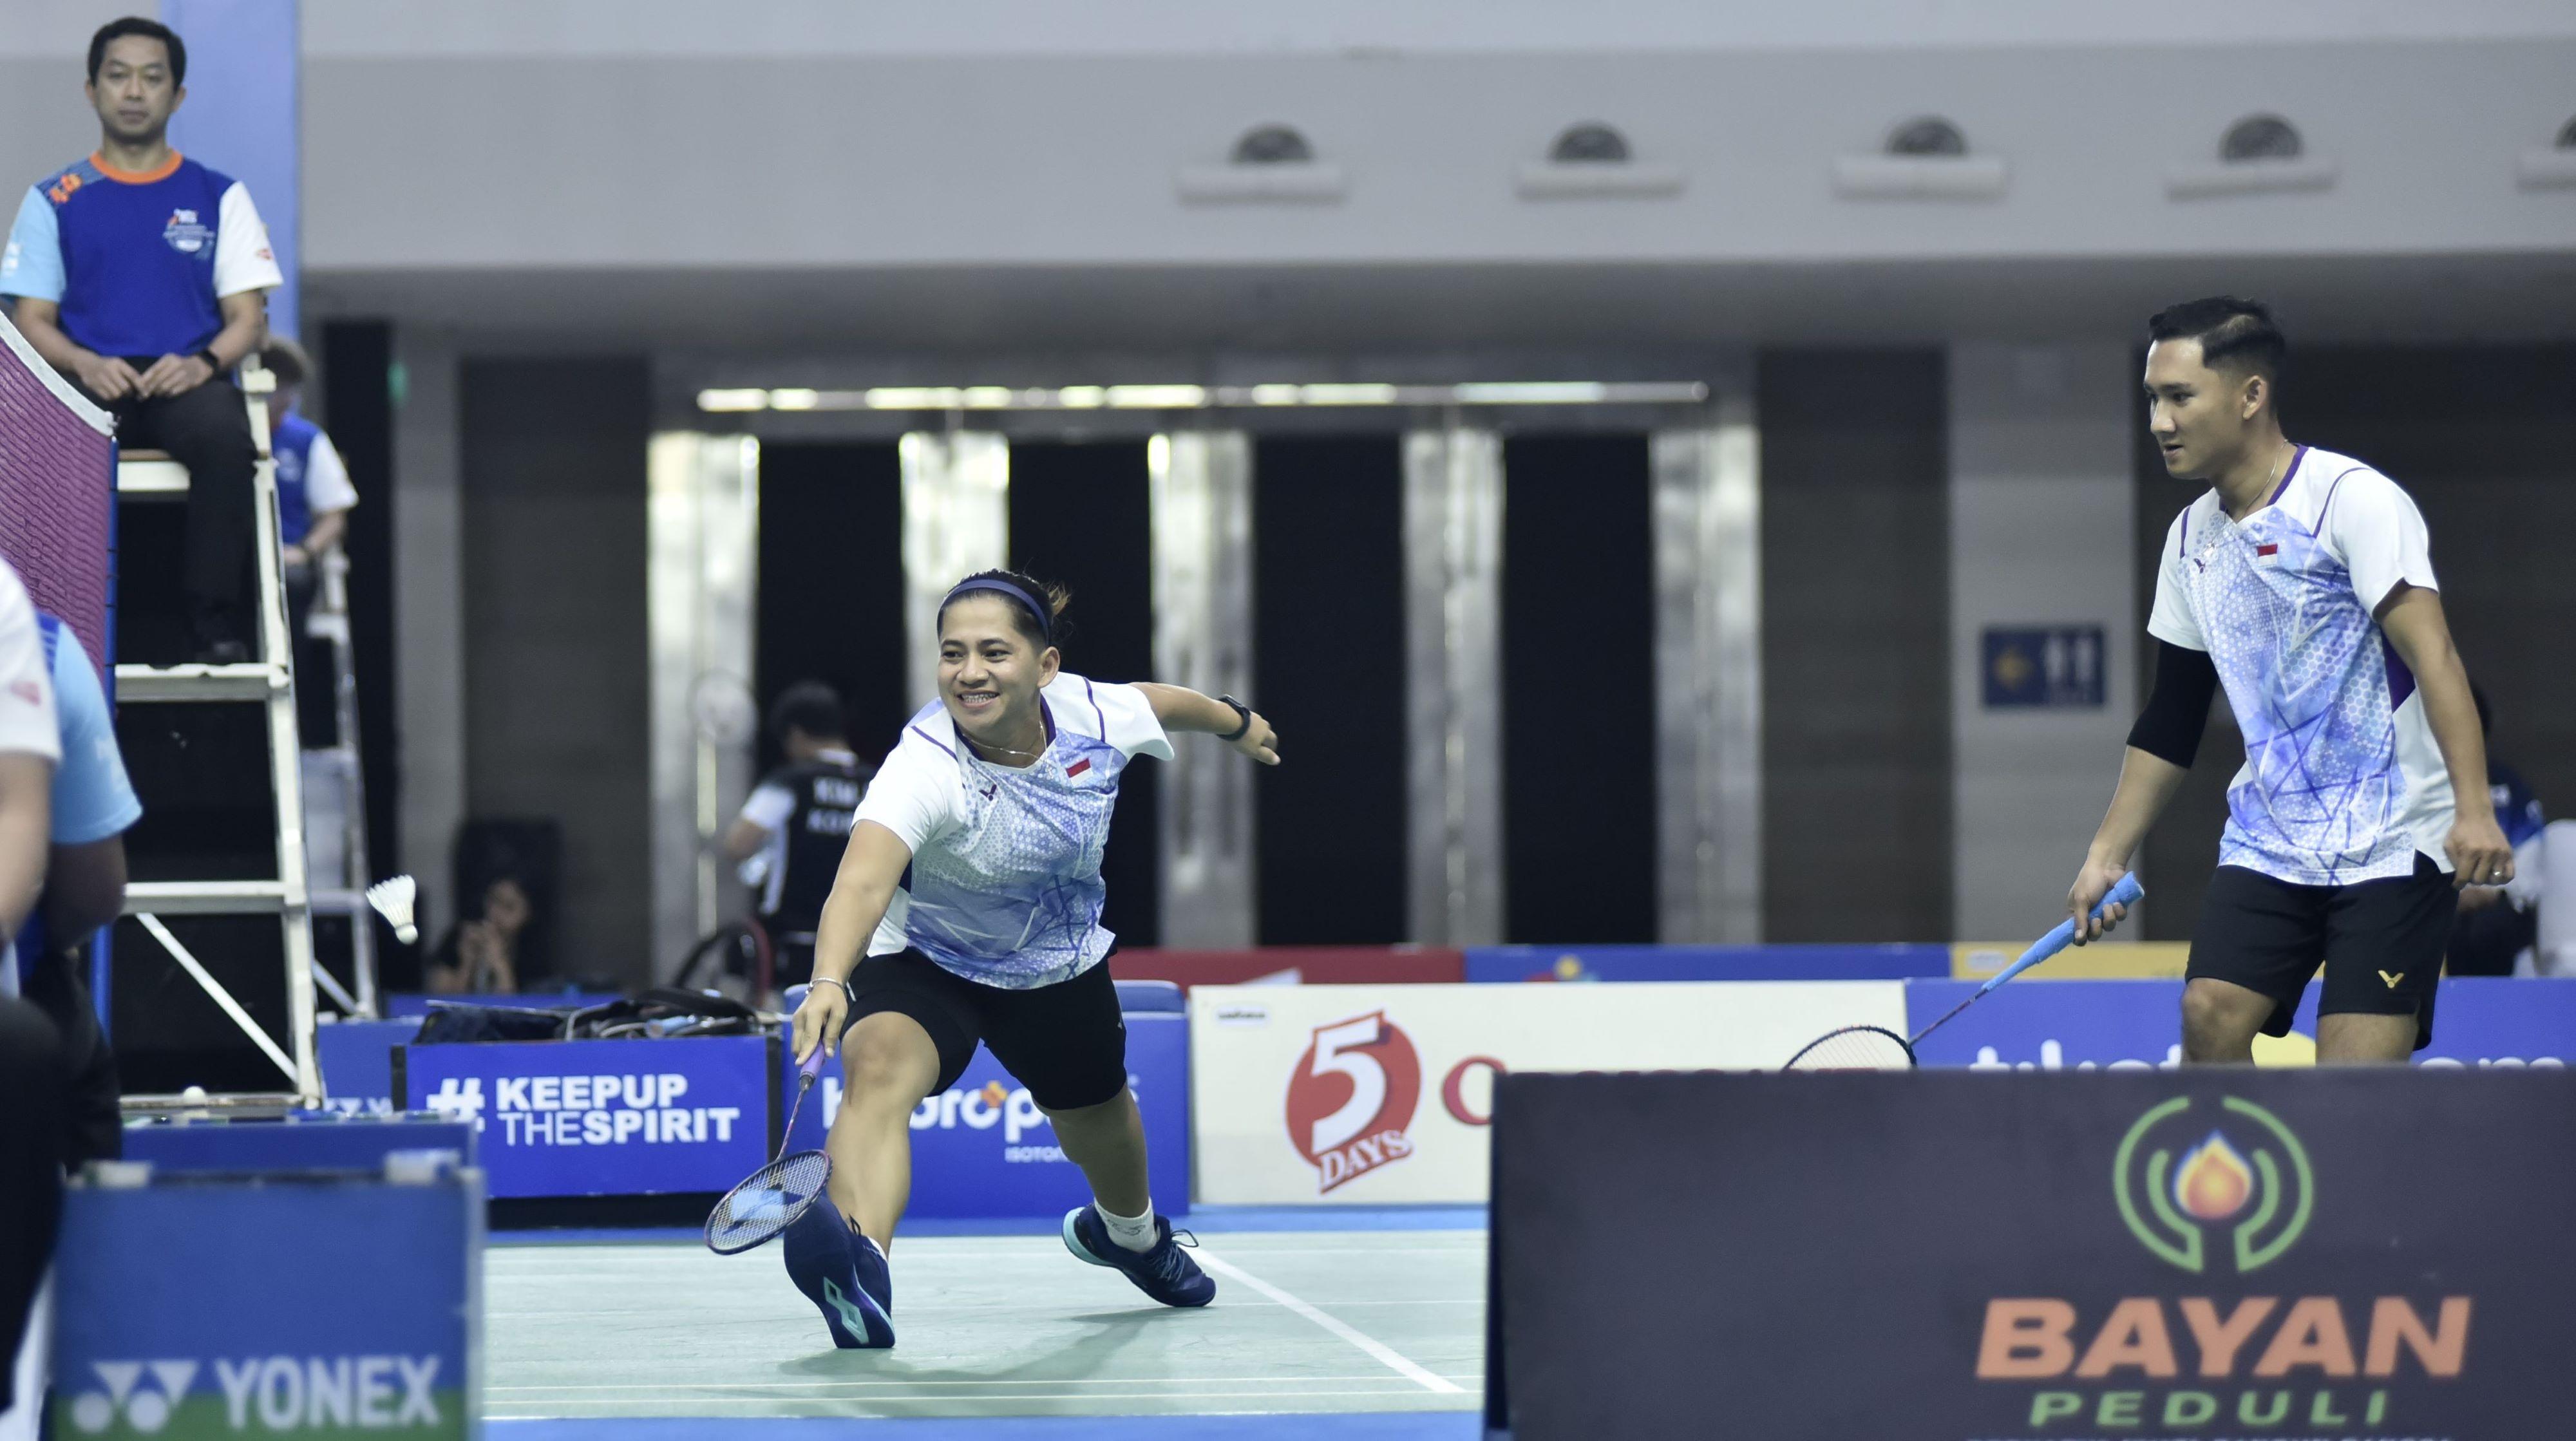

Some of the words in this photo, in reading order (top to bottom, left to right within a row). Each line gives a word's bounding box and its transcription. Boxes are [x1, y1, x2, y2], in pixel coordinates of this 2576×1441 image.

[1312, 1012, 1386, 1154] 5
[1320, 1130, 1413, 1187] DAYS
[1975, 1296, 2472, 1379] BAYAN
[215, 1355, 442, 1429] YONEX
[2029, 1390, 2387, 1427] PEDULI
